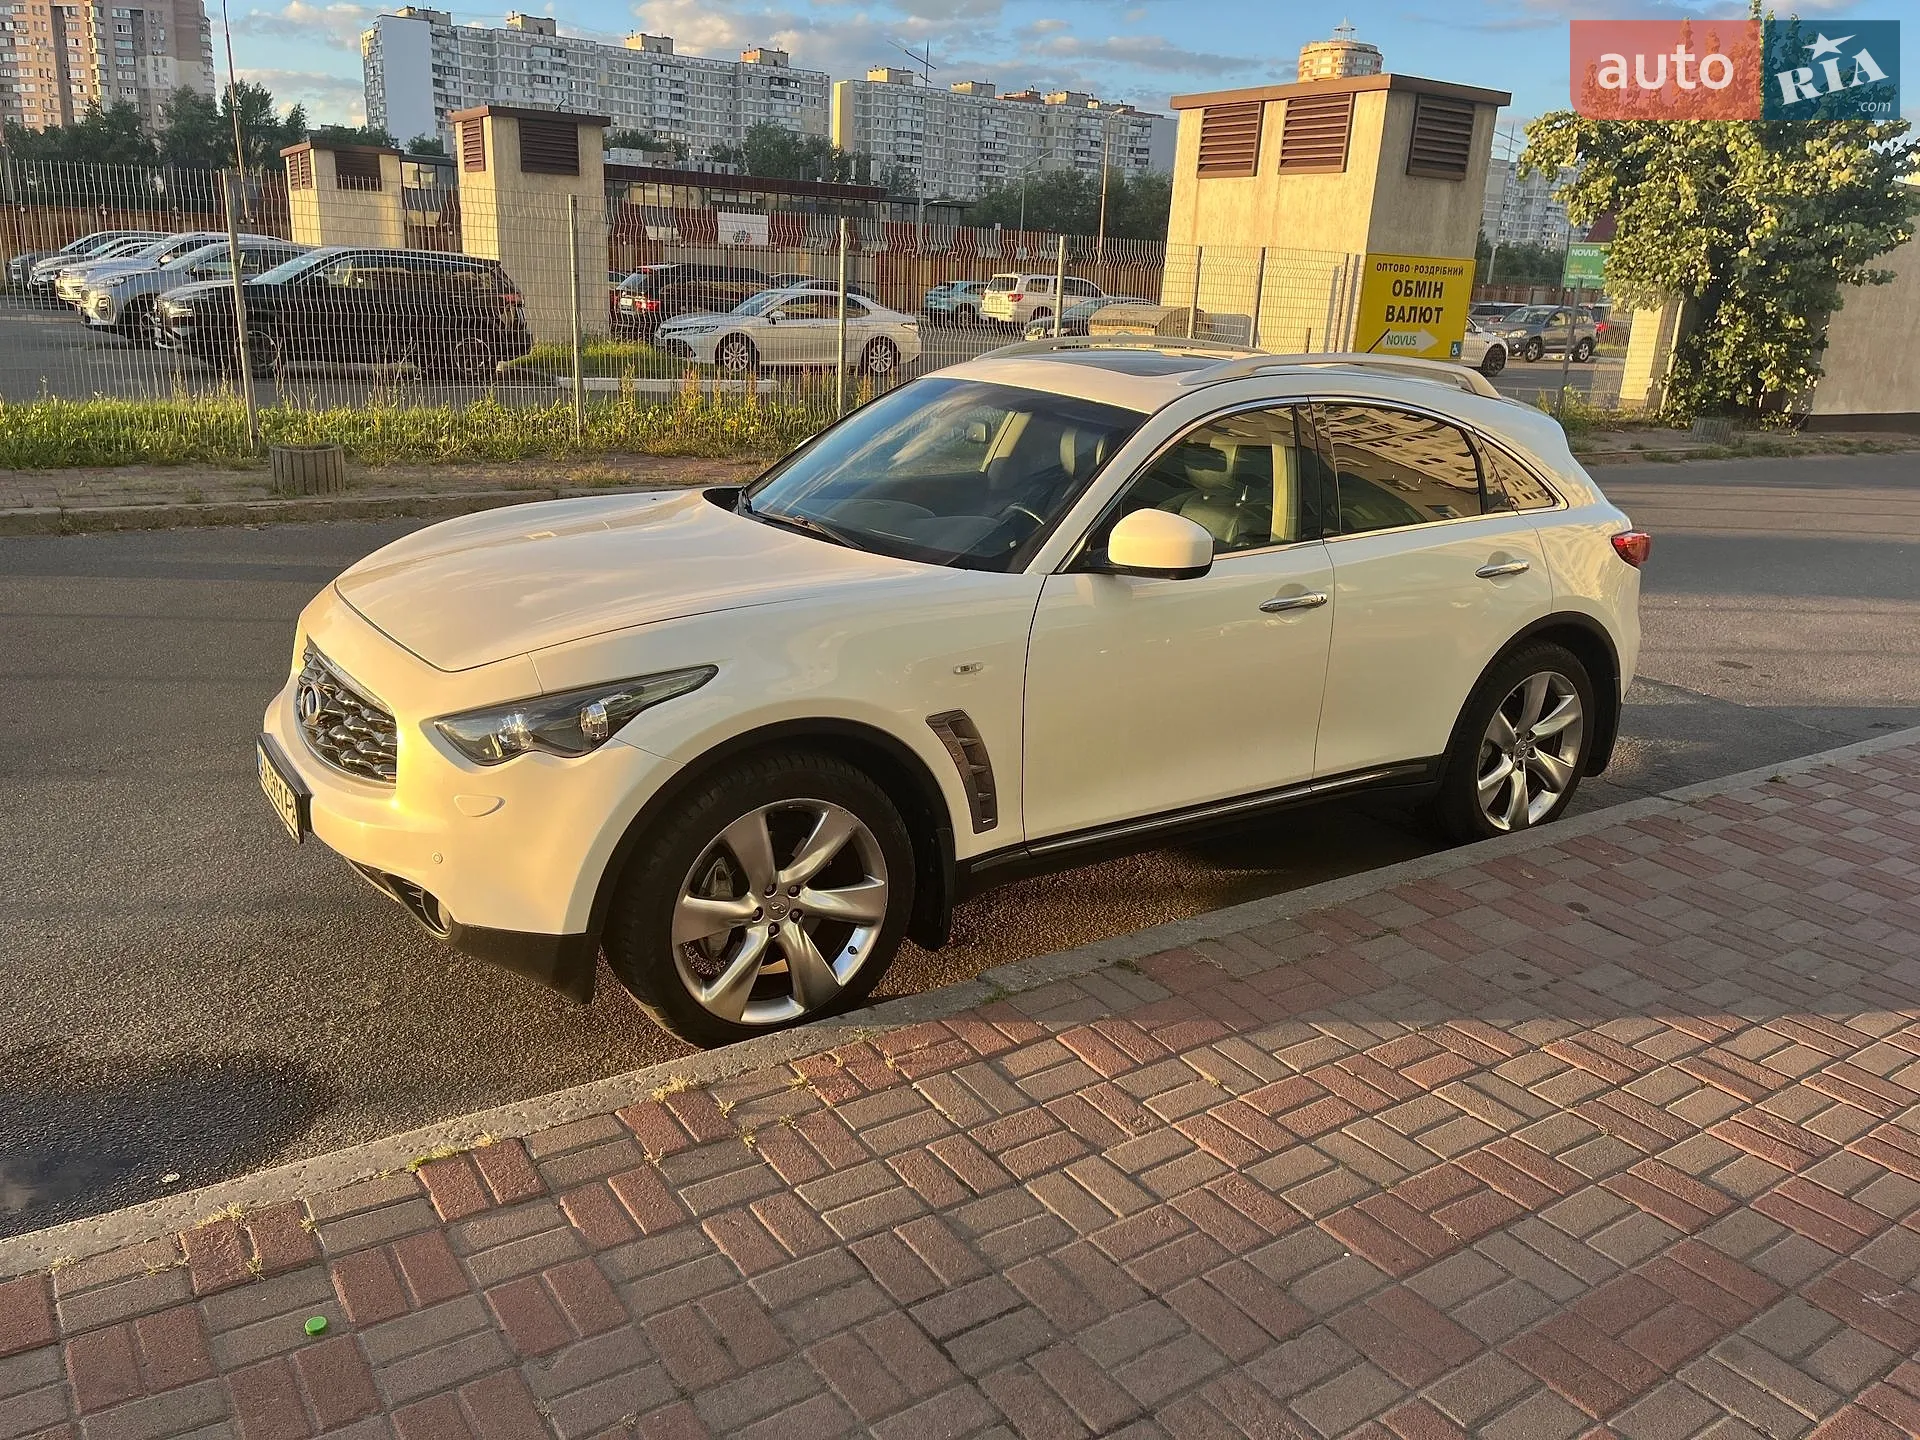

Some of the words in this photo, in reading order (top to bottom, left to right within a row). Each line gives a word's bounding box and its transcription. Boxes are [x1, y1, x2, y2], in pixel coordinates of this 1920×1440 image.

[1571, 249, 1599, 257] NOVUS
[1376, 262, 1410, 273] ОПТОВО
[1391, 279, 1444, 299] ОБМІН
[1384, 305, 1444, 324] ВАЛЮТ
[1386, 335, 1417, 346] NOVUS
